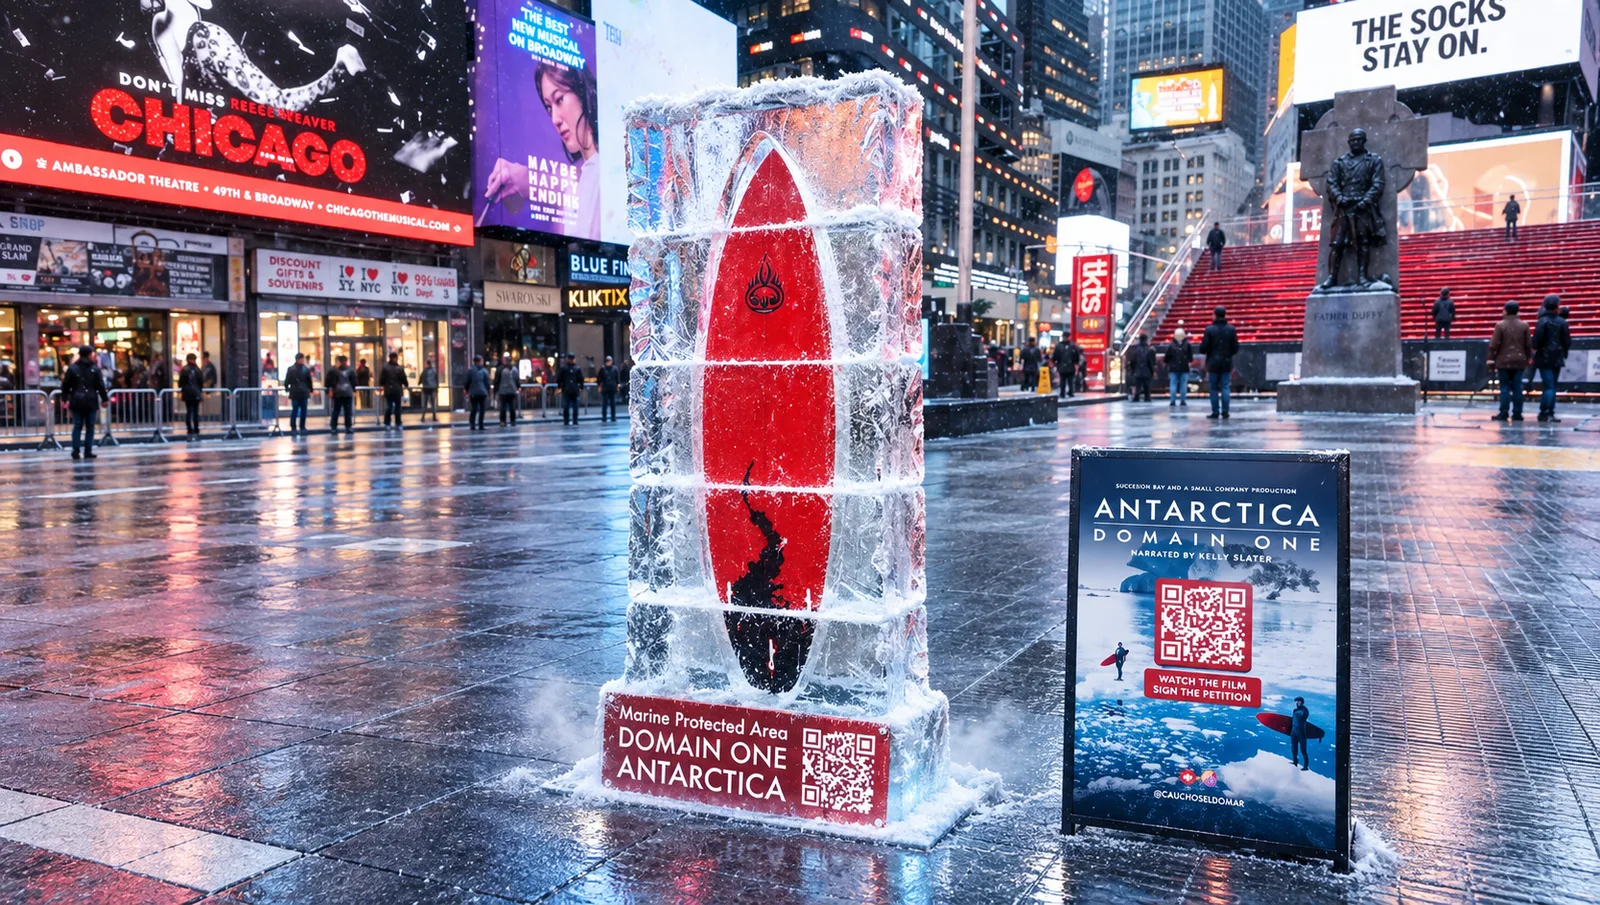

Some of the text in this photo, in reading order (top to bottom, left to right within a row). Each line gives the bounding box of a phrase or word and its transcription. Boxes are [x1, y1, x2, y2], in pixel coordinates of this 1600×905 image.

[1352, 0, 1506, 45] THE SOCKS
[512, 18, 580, 54] NEW MUSICAL
[508, 32, 525, 49] ON
[528, 39, 586, 70] BROADWAY
[1362, 29, 1487, 72] STAY ON.
[185, 88, 226, 108] MISS
[90, 88, 366, 184] CHICAGO
[528, 154, 578, 180] MAYBE
[528, 170, 578, 194] HAPPY
[52, 160, 450, 232] AMBASSADOR THEATRE 49TH & BROADWAY CHICAGOTHEMUSICAL.COM
[2, 251, 28, 262] SLAM
[270, 256, 321, 269] DISCOUNT
[570, 254, 608, 274] BLUE
[276, 268, 304, 278] GIFTS
[268, 278, 324, 291] SOUVENIRS
[360, 282, 381, 294] NYC
[391, 285, 409, 296] NYC
[443, 289, 450, 299] 3
[1082, 258, 1108, 314] tkts
[496, 290, 551, 306] SWAROVSKI
[568, 288, 628, 308] KLIKTIX
[1094, 498, 1320, 527] ANTARCTICA
[1094, 528, 1320, 551] DOMAIN ONE
[1130, 550, 1272, 563] NARRATED BY KELLY SLATER
[1158, 674, 1246, 690] WATCH THE FILM
[1153, 685, 1252, 702] SIGN THE PETITION
[620, 704, 788, 740] Marine Protected Area
[618, 726, 787, 770] DOMAIN ONE
[616, 755, 786, 802] ANTARCTICA
